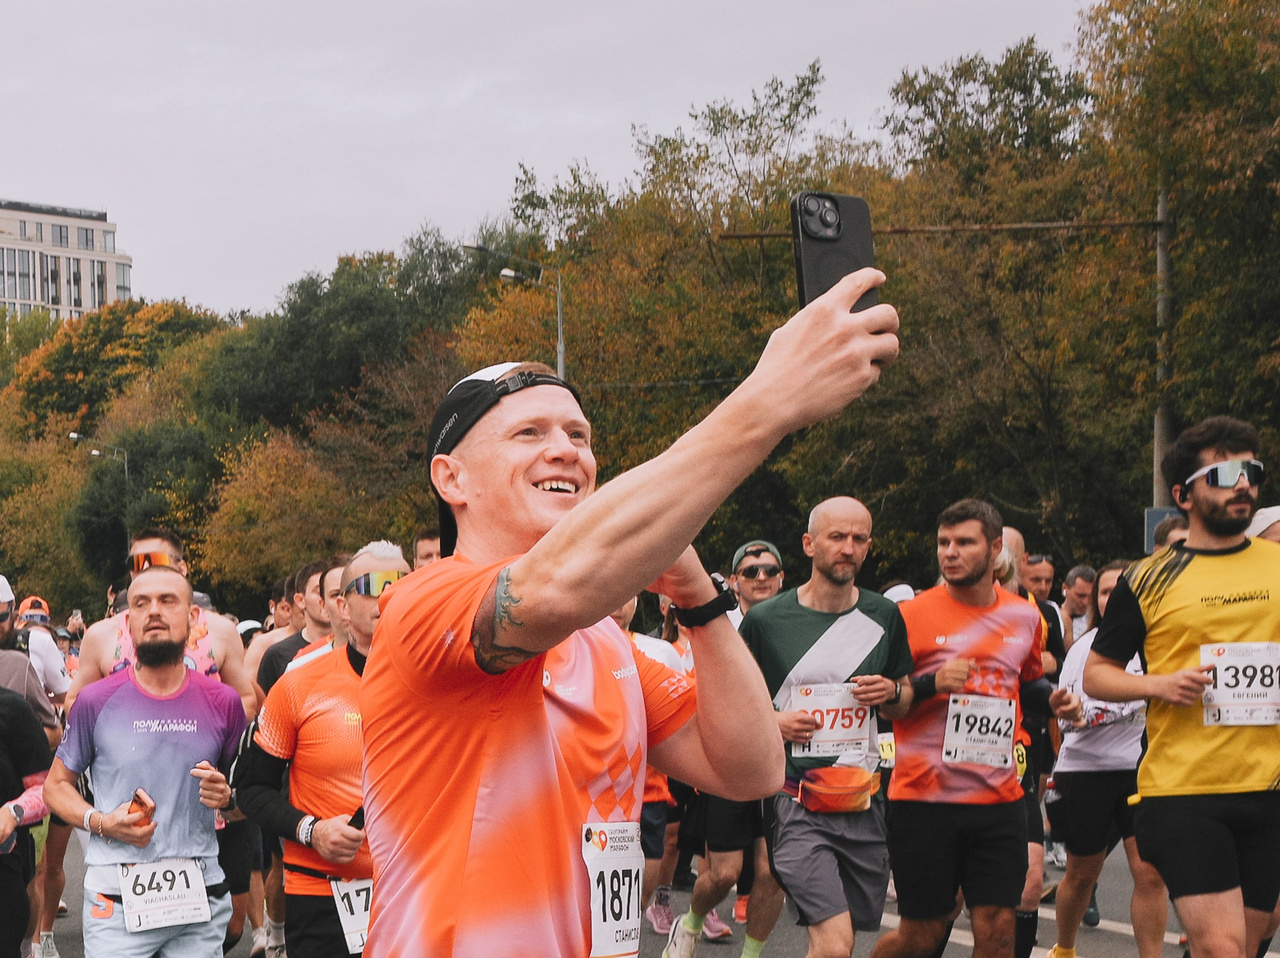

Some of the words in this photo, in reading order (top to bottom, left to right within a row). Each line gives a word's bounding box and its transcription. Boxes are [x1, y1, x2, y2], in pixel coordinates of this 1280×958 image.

[798, 707, 867, 730] 0759
[952, 713, 1013, 738] 19842
[132, 870, 190, 896] 6491
